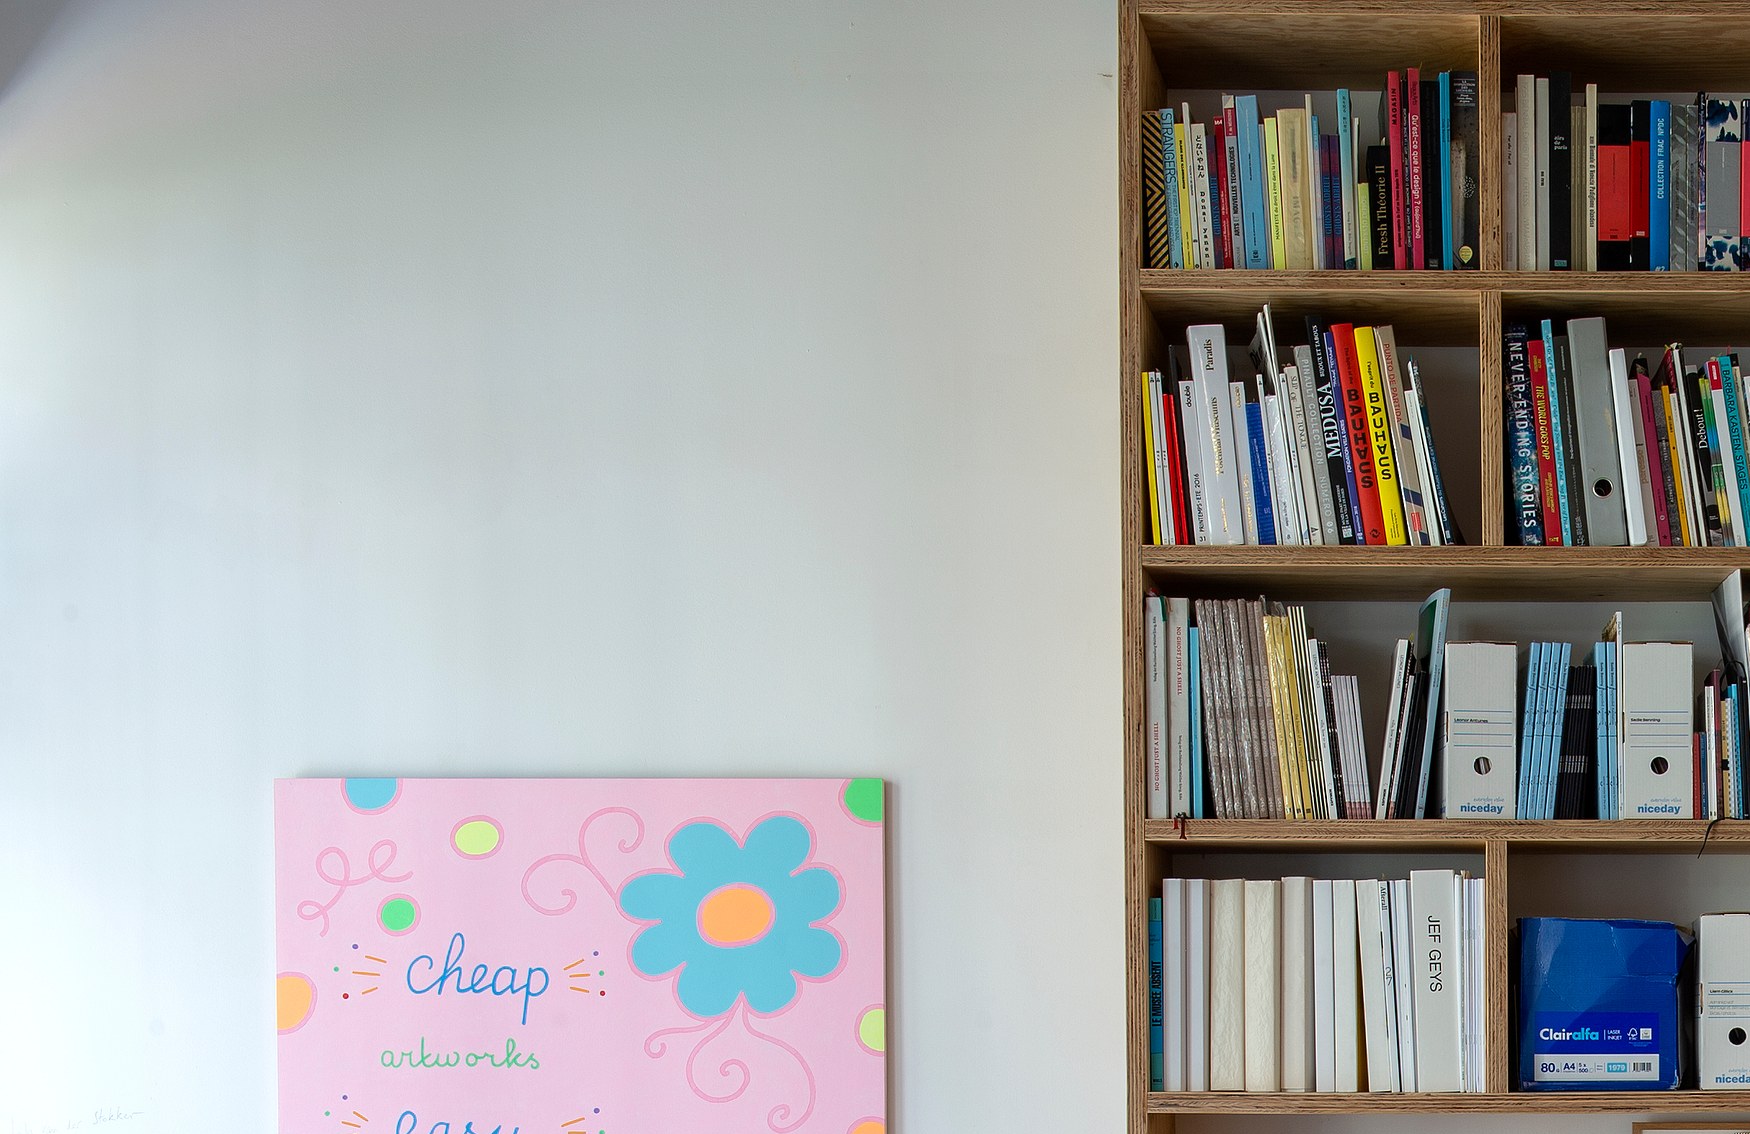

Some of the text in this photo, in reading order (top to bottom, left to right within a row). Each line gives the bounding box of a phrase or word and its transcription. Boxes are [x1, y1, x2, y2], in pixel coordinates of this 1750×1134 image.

[1161, 112, 1175, 189] STRANGERS
[1375, 164, 1389, 255] Fresh Théorie II
[1206, 339, 1214, 371] Paradis
[1317, 381, 1342, 458] MEDUSA
[1346, 388, 1374, 489] BAUHAUS
[1370, 393, 1392, 481] BAUHAUS
[1507, 342, 1536, 529] NEVER-ENDING STORIES
[1698, 408, 1707, 450] Debout!
[1722, 370, 1736, 412] BARBARA
[1734, 455, 1748, 490] STAGES
[1460, 802, 1503, 815] niceday
[1638, 803, 1681, 815] niceday
[1380, 886, 1388, 911] Afterall
[406, 933, 550, 1024] cheap
[1427, 916, 1443, 993] JEF GEYS
[381, 1038, 540, 1069] artworks
[1539, 1027, 1599, 1041] Clairalfa
[1563, 1062, 1575, 1071] A4
[1608, 1064, 1625, 1072] 1979
